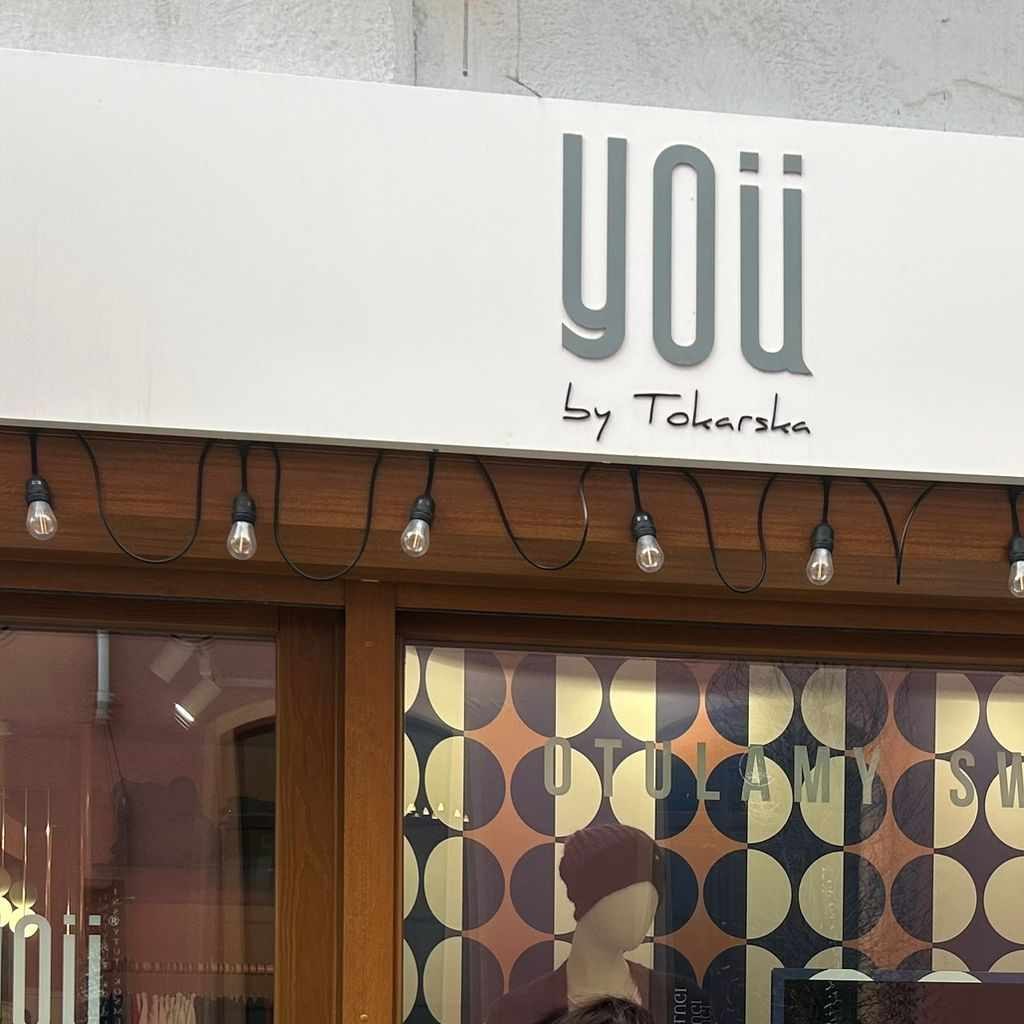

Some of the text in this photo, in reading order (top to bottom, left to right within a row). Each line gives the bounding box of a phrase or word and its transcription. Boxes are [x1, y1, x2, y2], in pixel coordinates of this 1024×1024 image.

[563, 382, 812, 442] by Tokarska
[543, 736, 881, 805] OTULAMY
